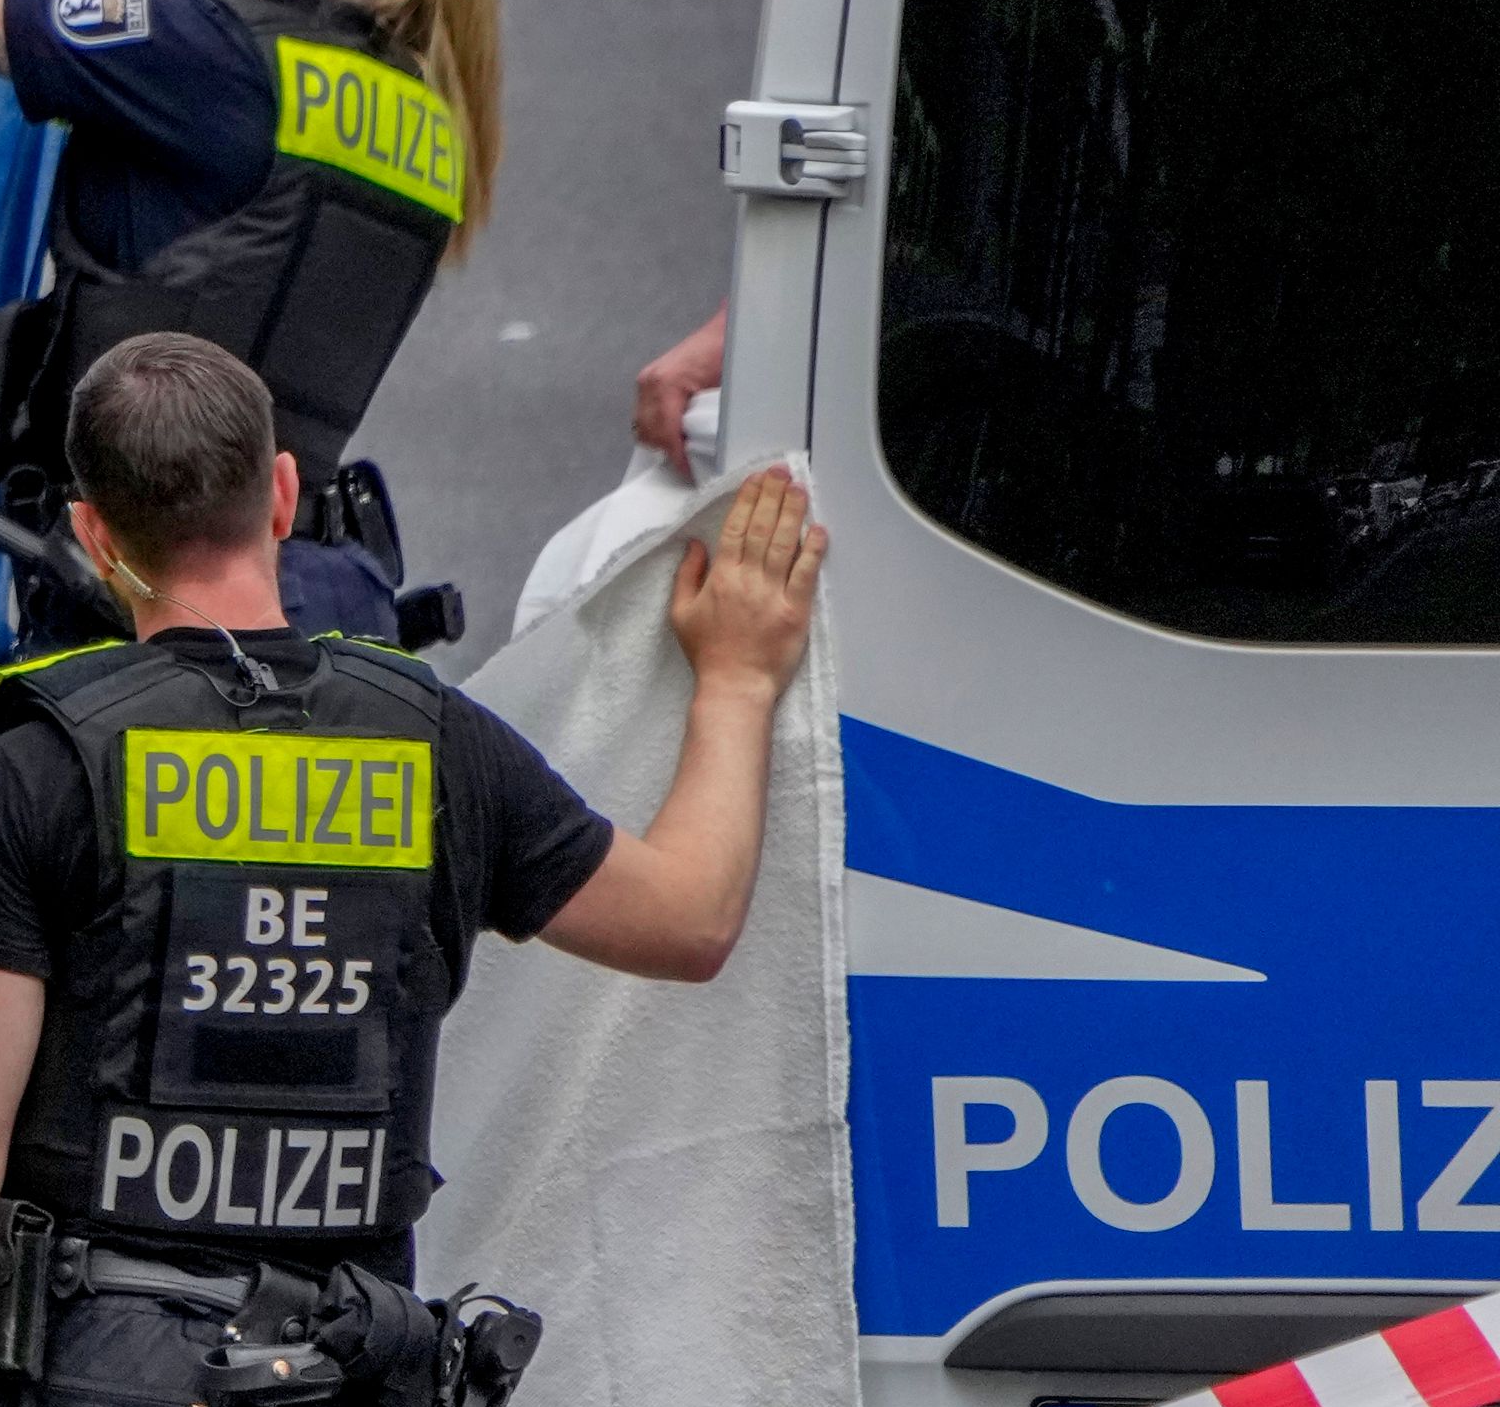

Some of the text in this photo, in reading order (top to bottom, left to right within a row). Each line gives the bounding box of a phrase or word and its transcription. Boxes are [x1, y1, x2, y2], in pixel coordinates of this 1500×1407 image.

[144, 751, 415, 849] POLIZEI
[245, 887, 329, 948] BE
[182, 956, 373, 1015] 32325
[101, 1116, 386, 1227] POLIZEI
[931, 1075, 1500, 1233] POLIZ
